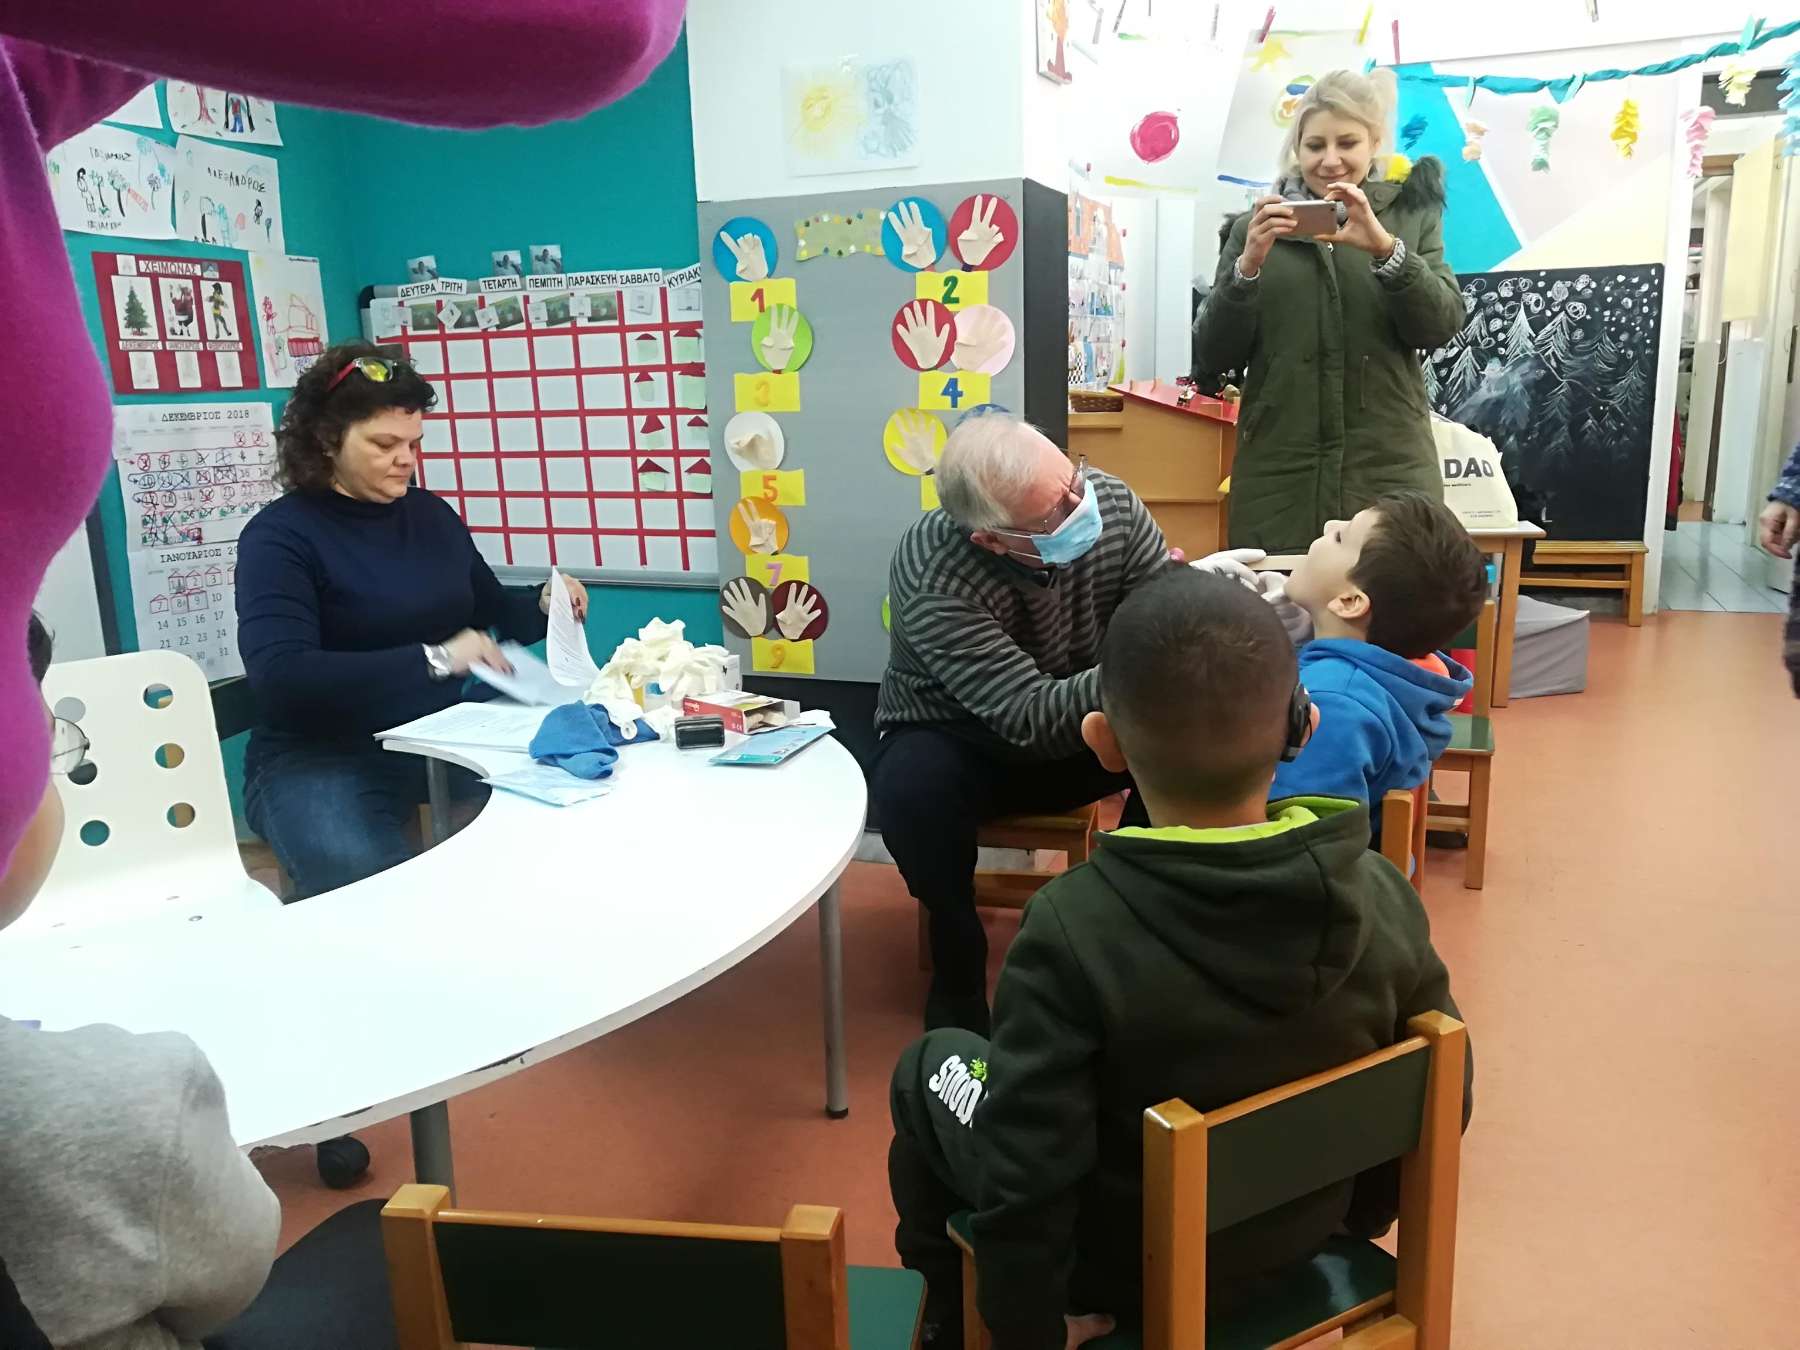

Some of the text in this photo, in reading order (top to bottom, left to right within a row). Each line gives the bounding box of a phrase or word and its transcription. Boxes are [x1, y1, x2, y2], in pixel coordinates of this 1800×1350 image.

[401, 286, 437, 298] ΔΕΥΤΕΡΑ
[441, 281, 463, 293] ΤΡΙΤΗ
[482, 278, 518, 290] ΤΕΤΑΡΤΗ
[529, 277, 563, 289] ΠΕΜΠΤΗ
[568, 274, 618, 287] ΠΑΡΑΣΚΕΥΗ
[619, 272, 661, 285] ΣΑΒΒΑΤΟ
[941, 275, 960, 304] 2
[750, 288, 766, 313] 1
[755, 380, 770, 407] 3
[941, 377, 963, 408] 4
[161, 410, 250, 422] ΔΕΚΕΜΒΡΙΟΣ 2018
[762, 475, 778, 501] 5
[160, 549, 222, 563] ΙΑΝΟΥΑΡΙΟΣ
[212, 575, 217, 584] 3
[766, 563, 783, 586] 7
[212, 593, 222, 602] 10
[158, 611, 224, 630] 14 15 16 17
[160, 629, 227, 649] 21 22 23 24
[219, 648, 229, 657] 31
[769, 646, 785, 669] 9
